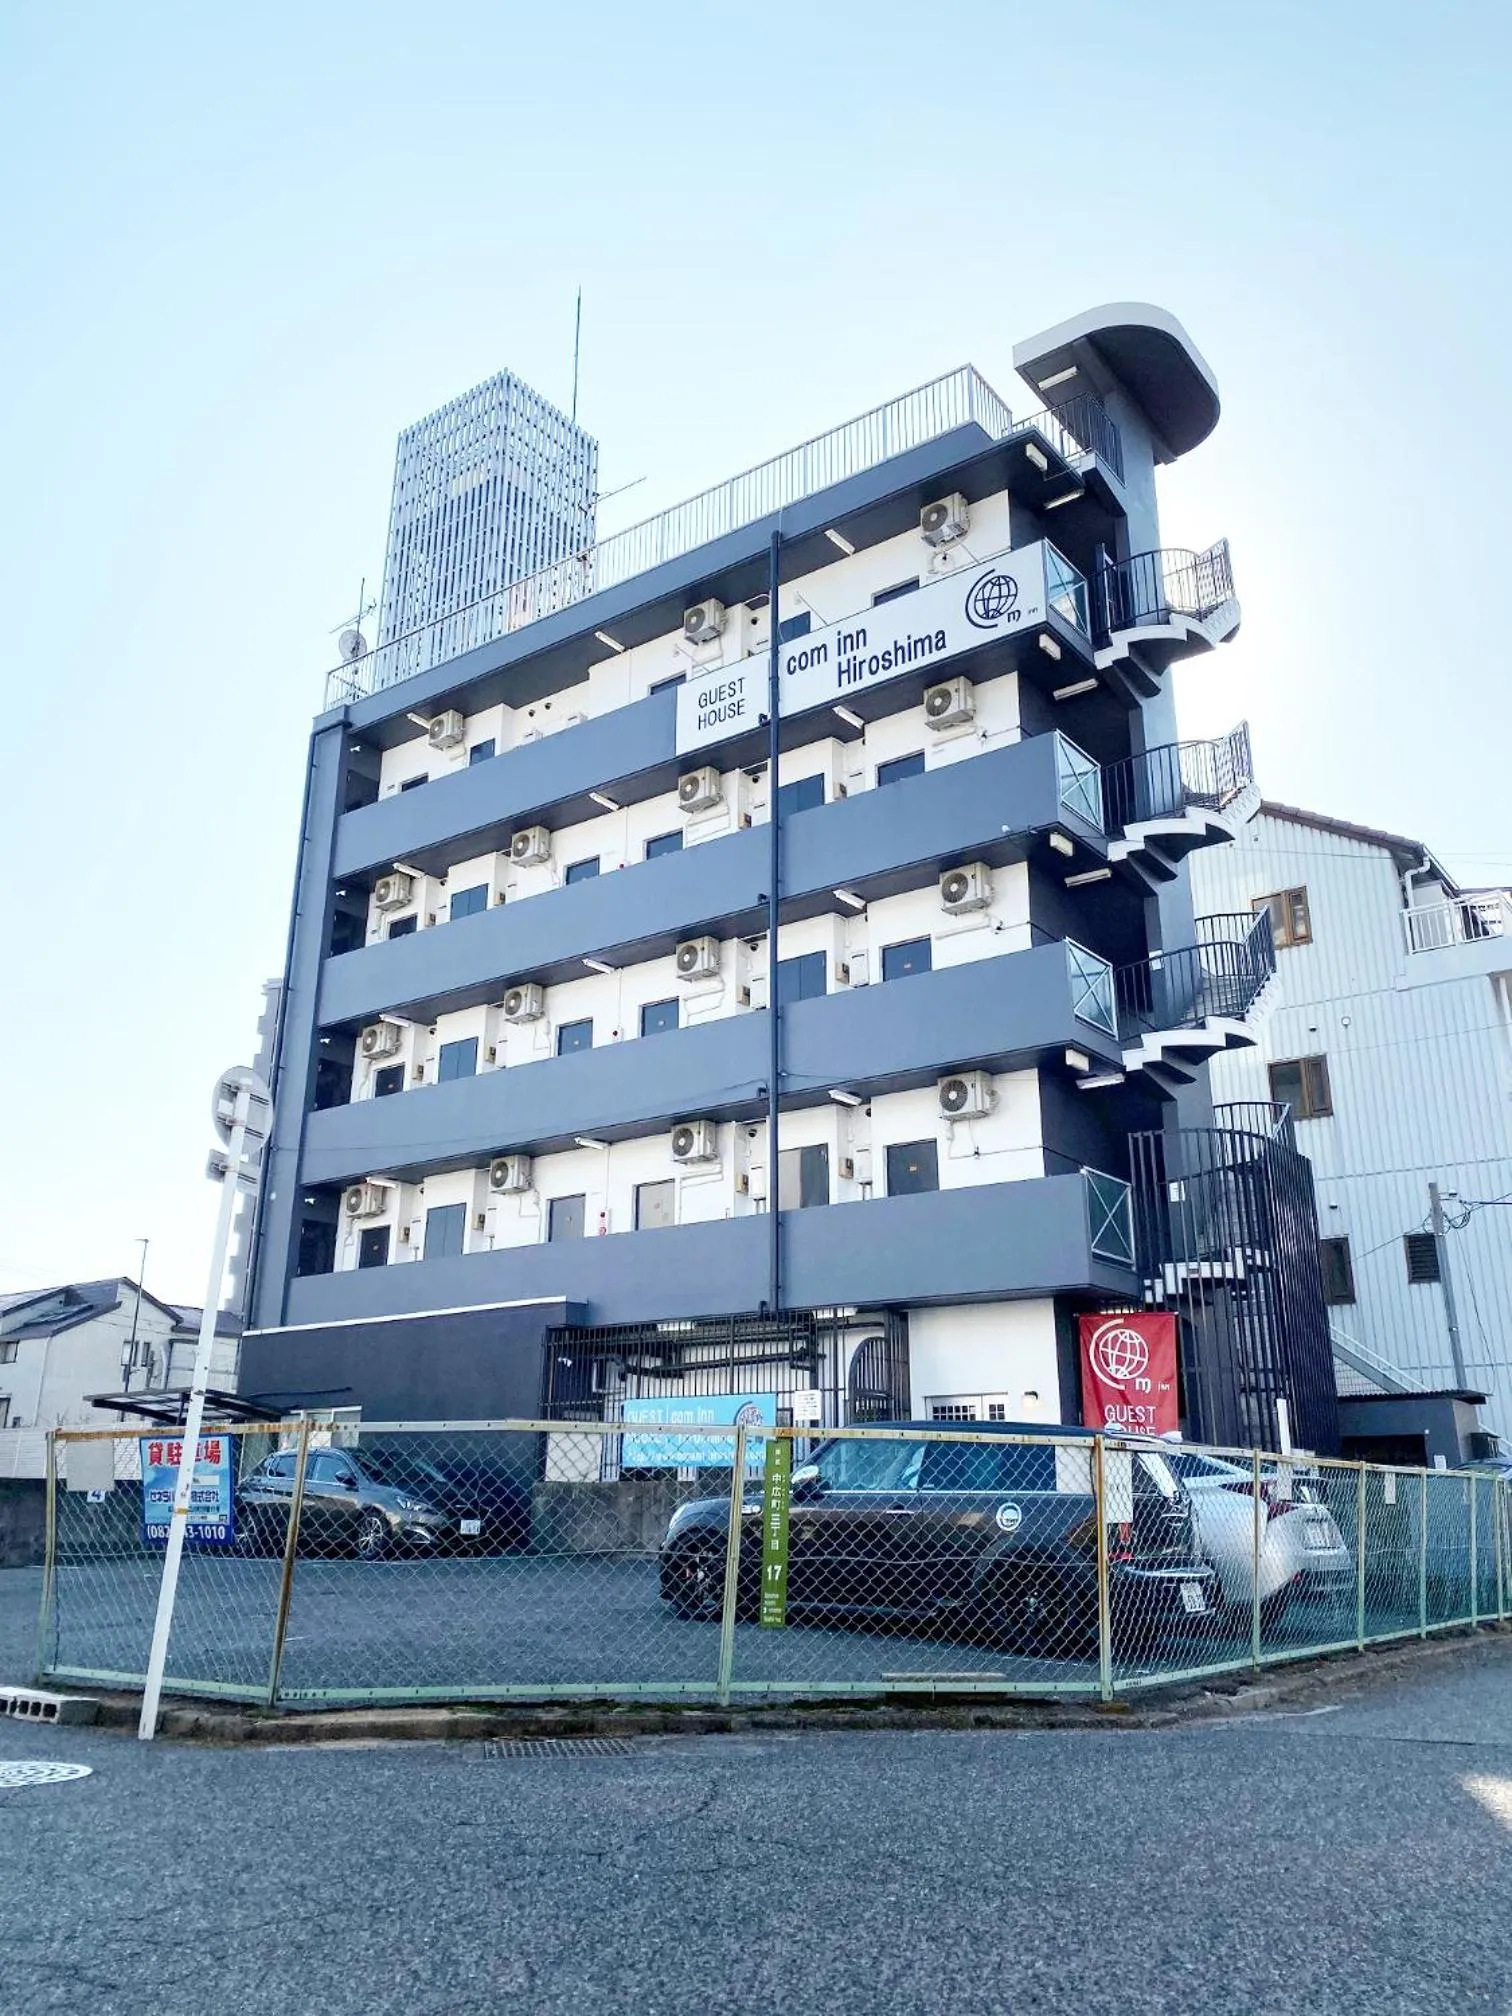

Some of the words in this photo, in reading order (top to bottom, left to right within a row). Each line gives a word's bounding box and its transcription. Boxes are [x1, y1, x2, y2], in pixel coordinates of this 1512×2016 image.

[787, 643, 828, 675] com
[837, 628, 867, 656] inn
[838, 629, 947, 688] Hiroshima
[698, 676, 746, 709] GUEST
[698, 698, 746, 731] HOUSE
[1104, 1403, 1157, 1423] GUEST
[770, 1472, 782, 1551] 中広町三丁目
[766, 1564, 782, 1581] 17
